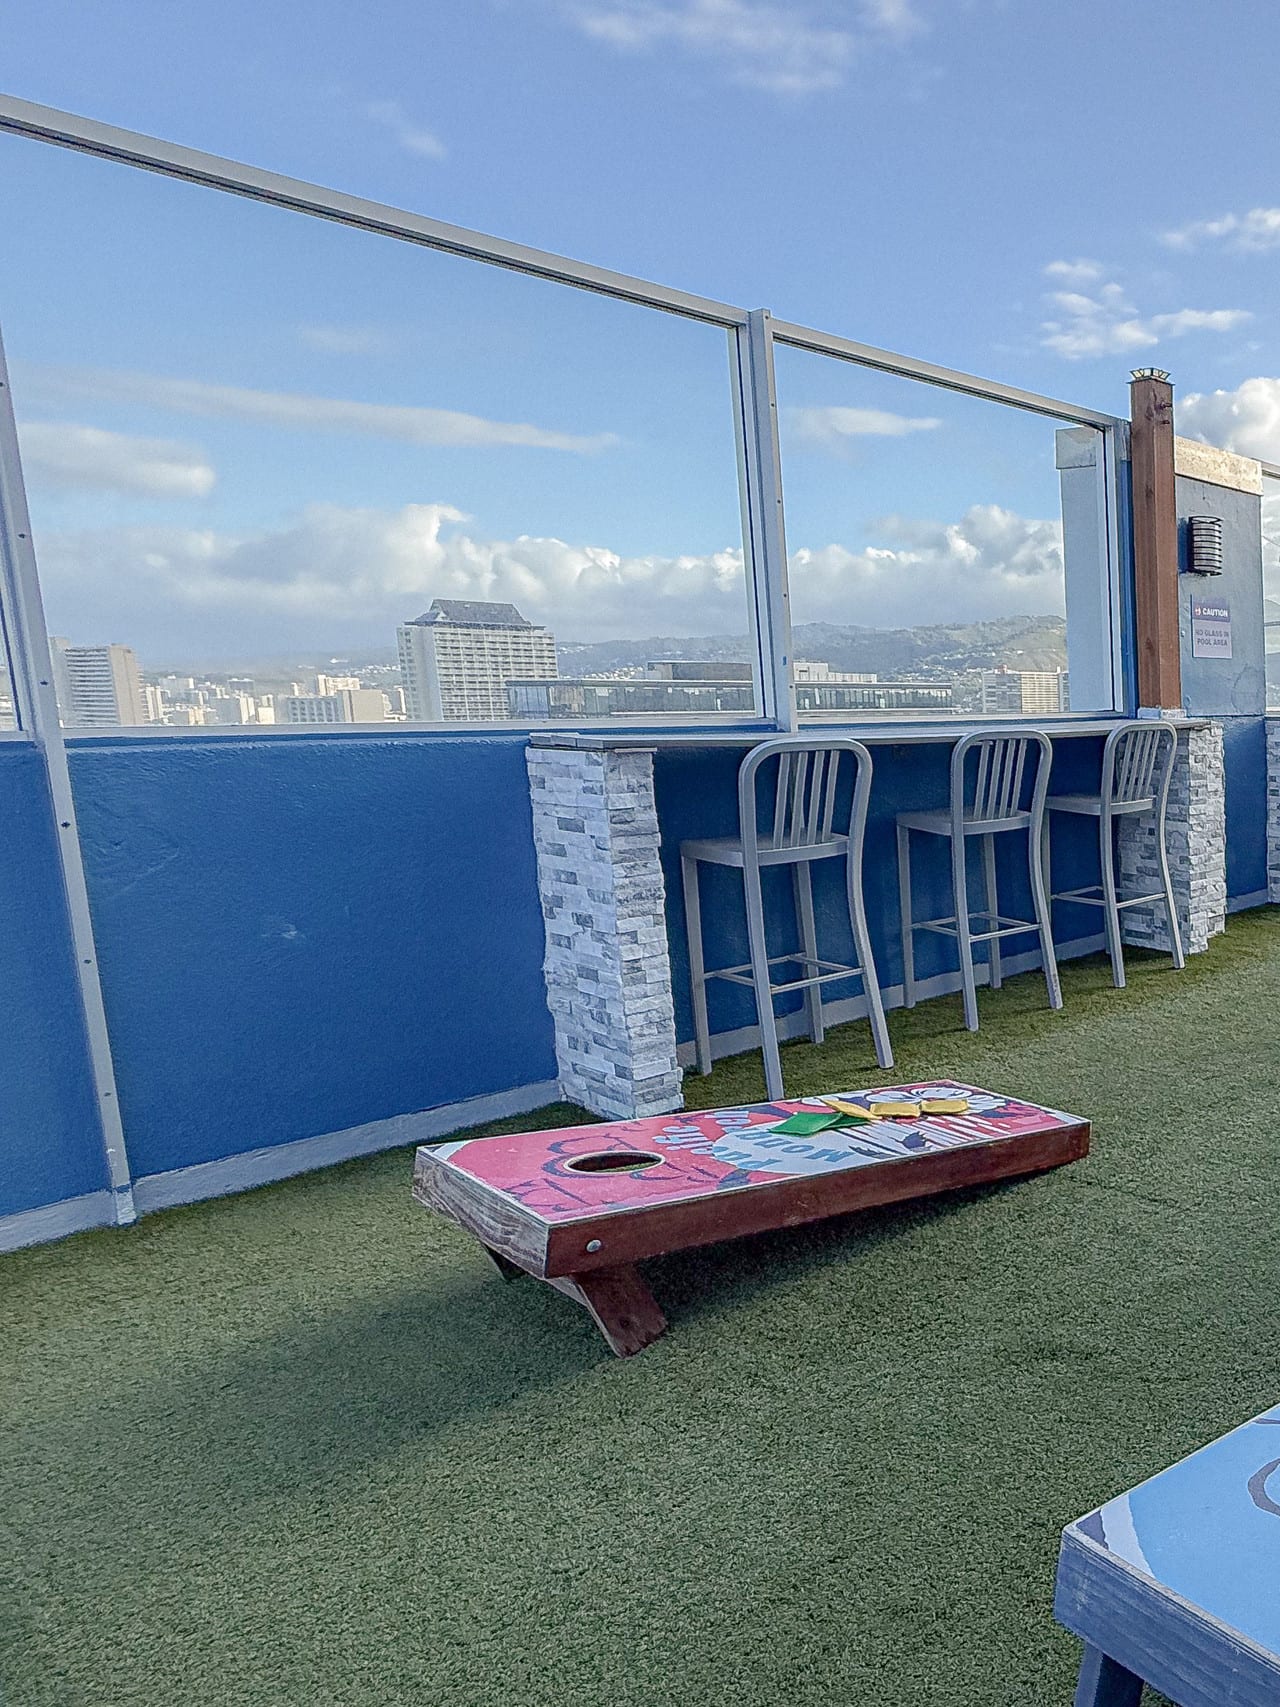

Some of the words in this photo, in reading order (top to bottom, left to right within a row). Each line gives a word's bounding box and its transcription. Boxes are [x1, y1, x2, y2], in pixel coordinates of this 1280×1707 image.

[1202, 607, 1229, 618] CAUTION
[1204, 630, 1223, 638] GLASS
[1197, 638, 1212, 646] POOL
[1212, 639, 1228, 647] AREA
[652, 1125, 783, 1171] Pacific
